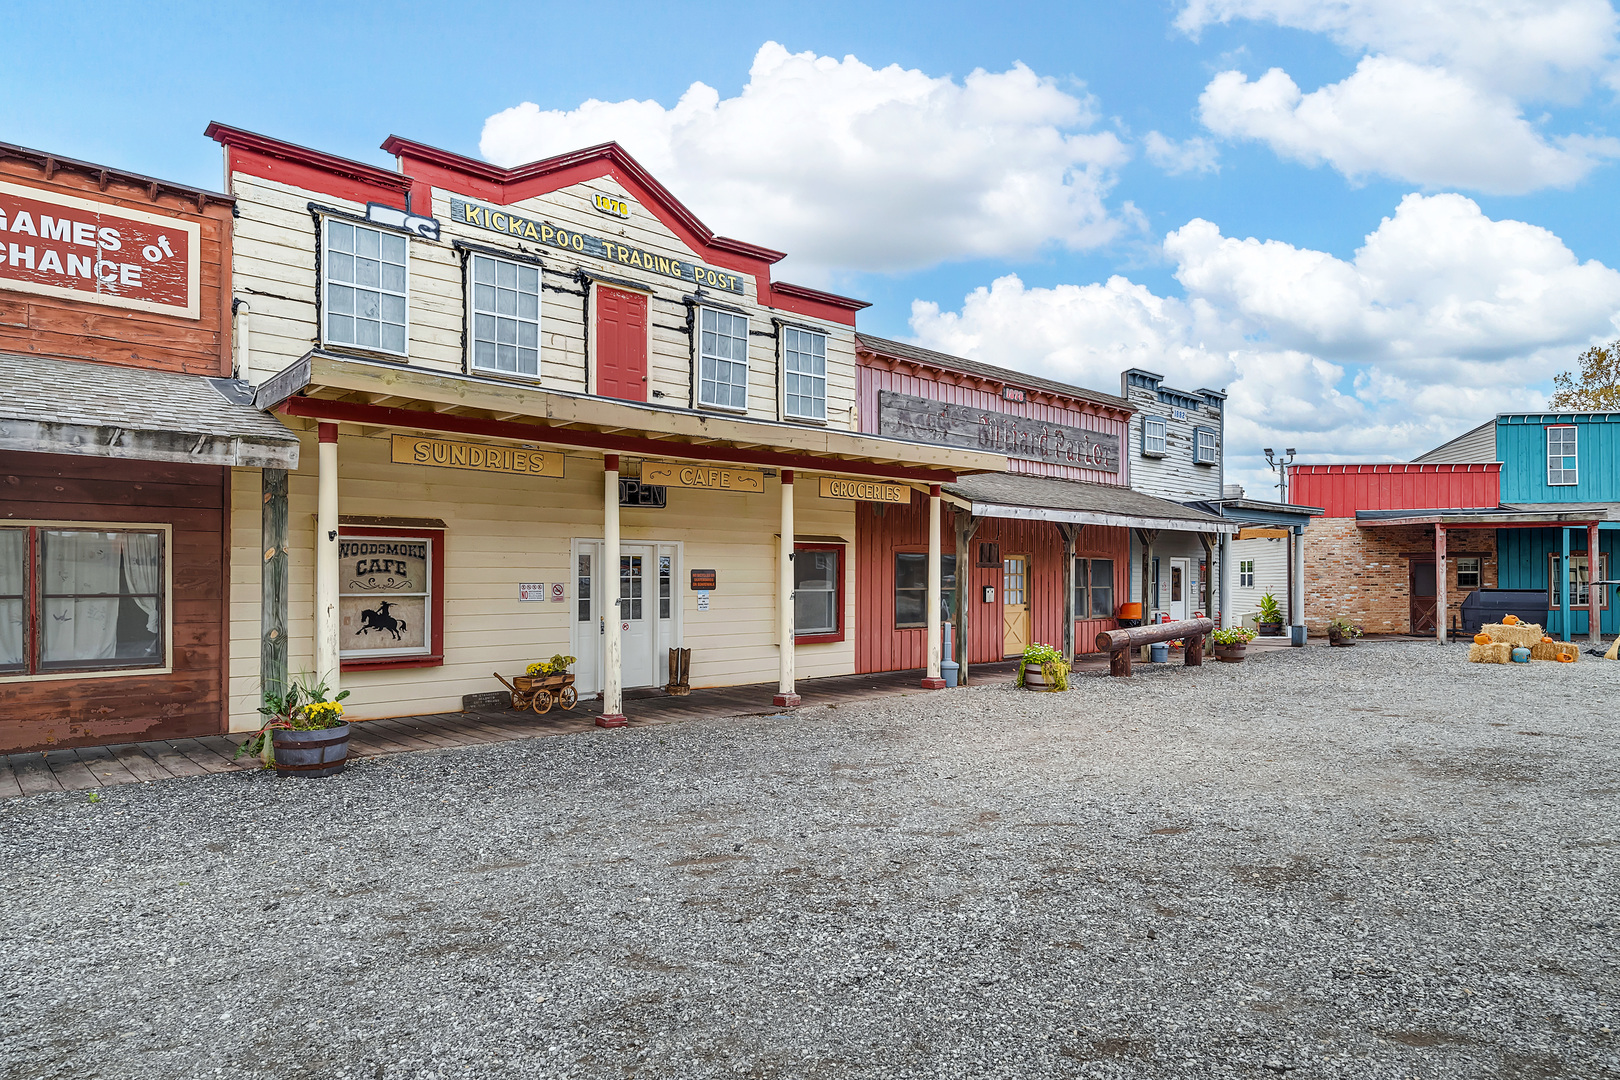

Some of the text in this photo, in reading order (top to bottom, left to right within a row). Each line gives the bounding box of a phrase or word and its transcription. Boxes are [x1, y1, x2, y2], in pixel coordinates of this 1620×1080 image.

[0, 207, 175, 263] AMES of
[464, 203, 737, 291] KICKAPOO TRADING POST
[0, 241, 143, 288] HANCE
[413, 441, 545, 473] SUNDRIES
[679, 467, 731, 488] CAFE
[829, 480, 901, 502] GROCERIES
[339, 542, 427, 560] WOODSMOKE
[355, 558, 408, 579] CAFE
